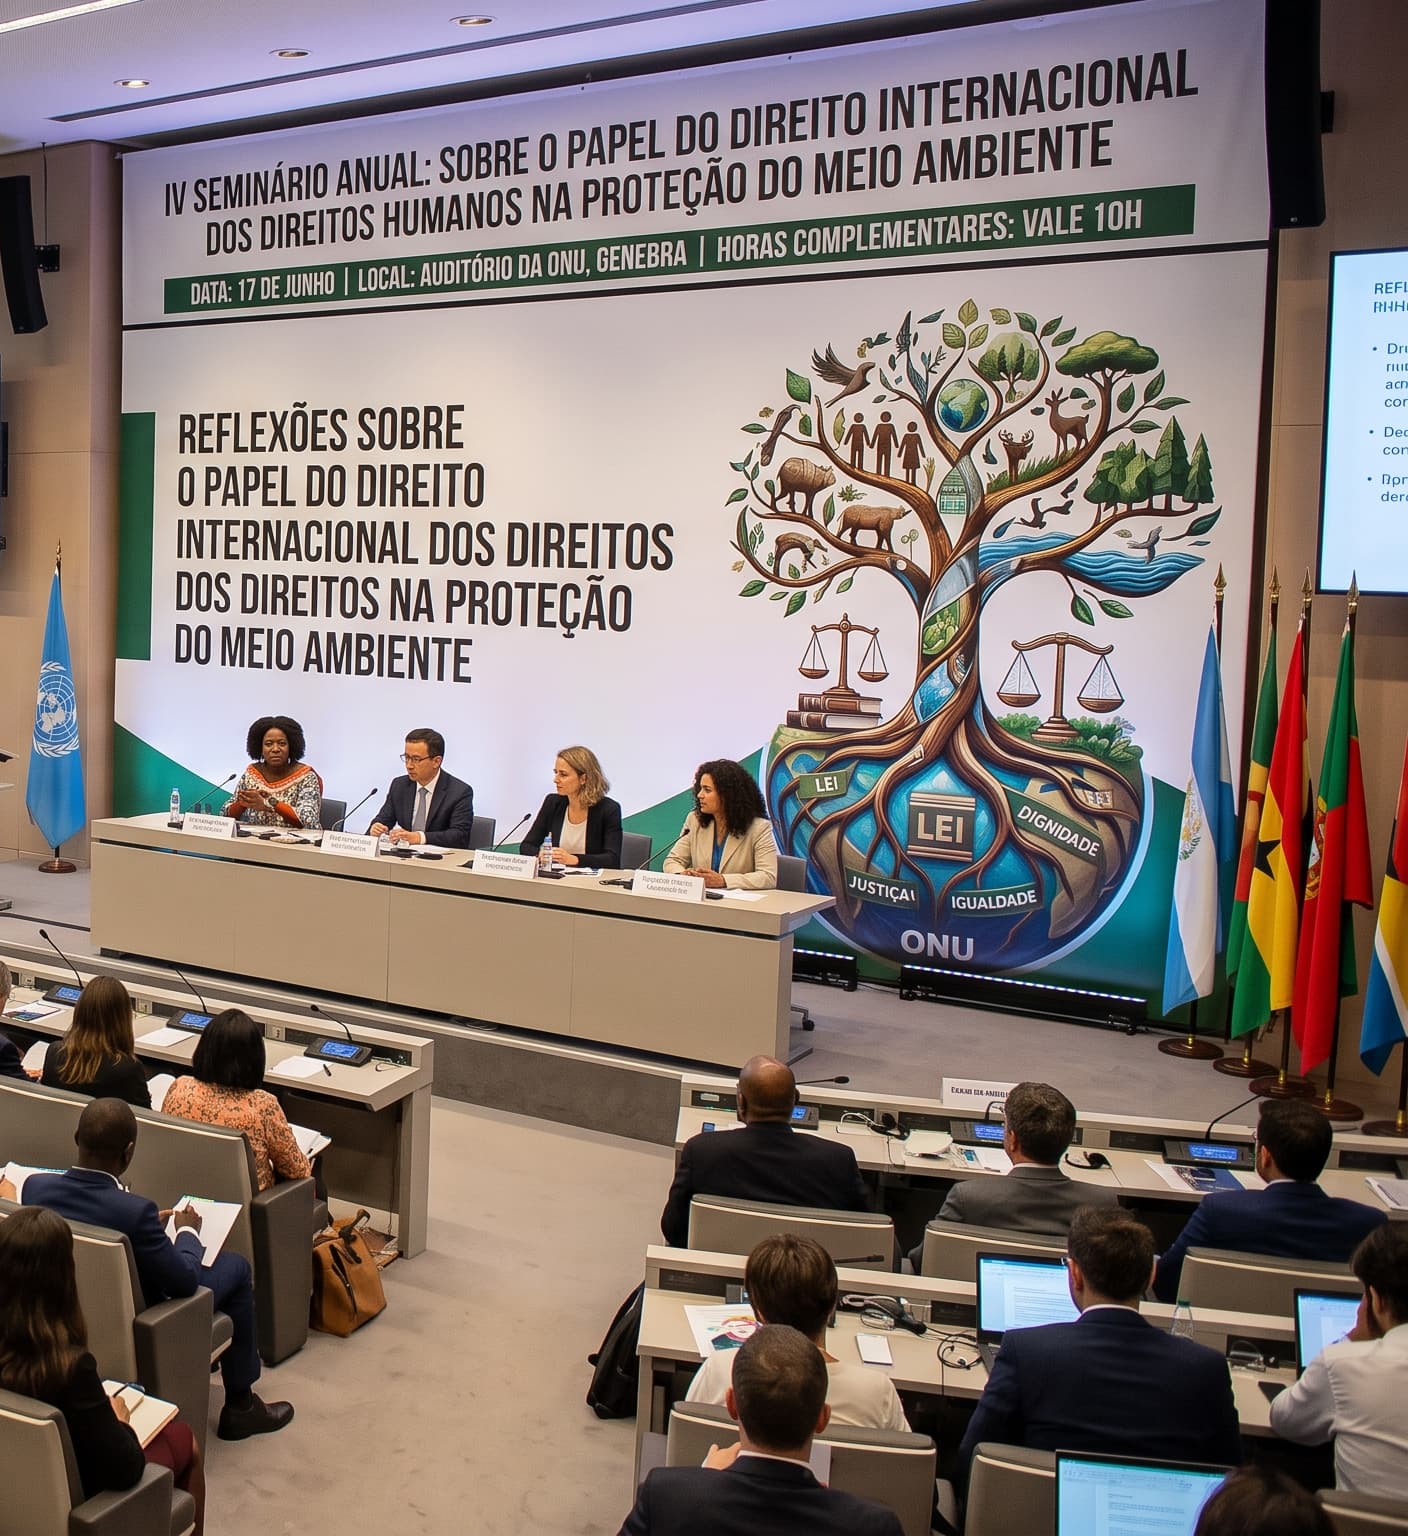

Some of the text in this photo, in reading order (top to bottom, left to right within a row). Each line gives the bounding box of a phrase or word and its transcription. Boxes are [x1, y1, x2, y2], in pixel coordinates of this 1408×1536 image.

[165, 47, 1200, 217] IV SEMINÁRIO ANUAL: SOBRE O PAPEL DO DIREITO INTERNACIONAL
[206, 119, 1114, 257] DOS DIREITOS HUMANOS NA PROTEÇÃO DO MEIO AMBIENTE
[191, 280, 232, 305] DATA:
[238, 277, 256, 302] 17
[260, 275, 281, 300] DE
[284, 270, 335, 298] JUNHO
[358, 264, 415, 292] LOCAL:
[419, 252, 513, 287] AUDITÓRIO
[518, 253, 543, 279] DA
[547, 248, 591, 277] ONU,
[596, 239, 687, 273] GENEBRA
[717, 230, 787, 263] HORAS
[793, 211, 1014, 257] COMPLEMENTARES:
[1022, 204, 1084, 238] VALE
[1094, 199, 1142, 232] 10H
[179, 401, 465, 454] REFLEXÕES SOBRE
[178, 462, 485, 508] O PAPEL DO DIREITO
[177, 519, 674, 571] INTERNACIONAL DOS DIREITOS
[175, 571, 632, 639] DOS DIREITOS NA PROTEÇÃO
[175, 623, 473, 684] DO MEIO AMBIENTE
[814, 775, 839, 793] LEI
[917, 812, 964, 843] LEI
[1017, 805, 1102, 857] DIGNIDADE
[950, 889, 1038, 910] IGUALDADE
[901, 929, 974, 960] ONU
